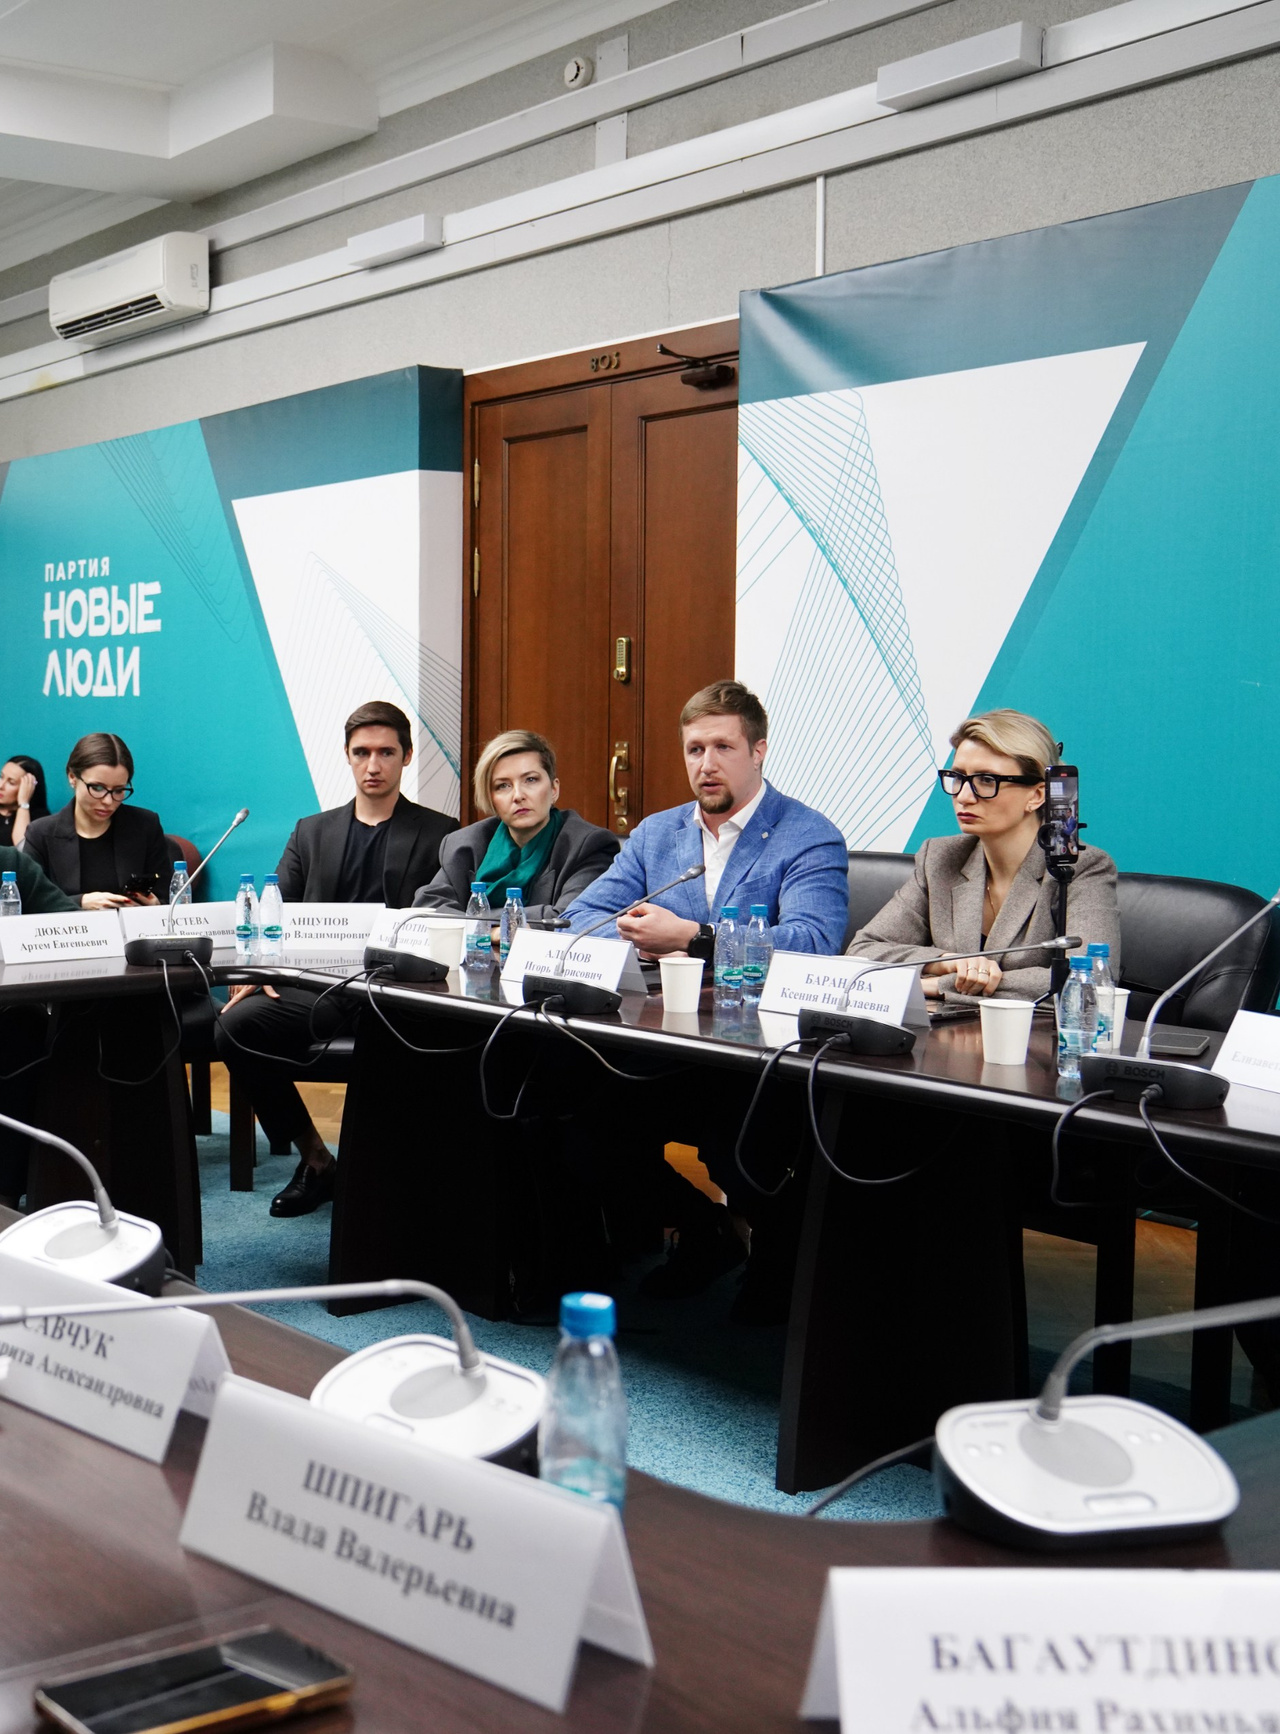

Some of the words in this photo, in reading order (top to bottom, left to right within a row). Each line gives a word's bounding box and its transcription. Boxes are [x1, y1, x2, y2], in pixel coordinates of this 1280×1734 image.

[44, 556, 110, 583] ПАРТИЯ
[42, 580, 162, 639] НОВЫЕ
[42, 645, 140, 698] ЛЮДИ
[34, 925, 89, 938] ДЮКАРЕВ
[289, 917, 349, 929] АНЦУПОВ
[20, 942, 51, 953] Артем
[52, 939, 108, 950] Евгеньевич
[524, 960, 551, 975] Игорь
[780, 987, 819, 1003] Ксения
[824, 1016, 854, 1029] BOSCH
[1231, 1050, 1280, 1072] Елизавет
[1123, 1065, 1166, 1080] BOSCH
[37, 1354, 165, 1420] Александровна
[301, 1459, 476, 1554] ШПИГАРЬ
[243, 1490, 328, 1551] Влада
[332, 1525, 519, 1631] Валерьевна
